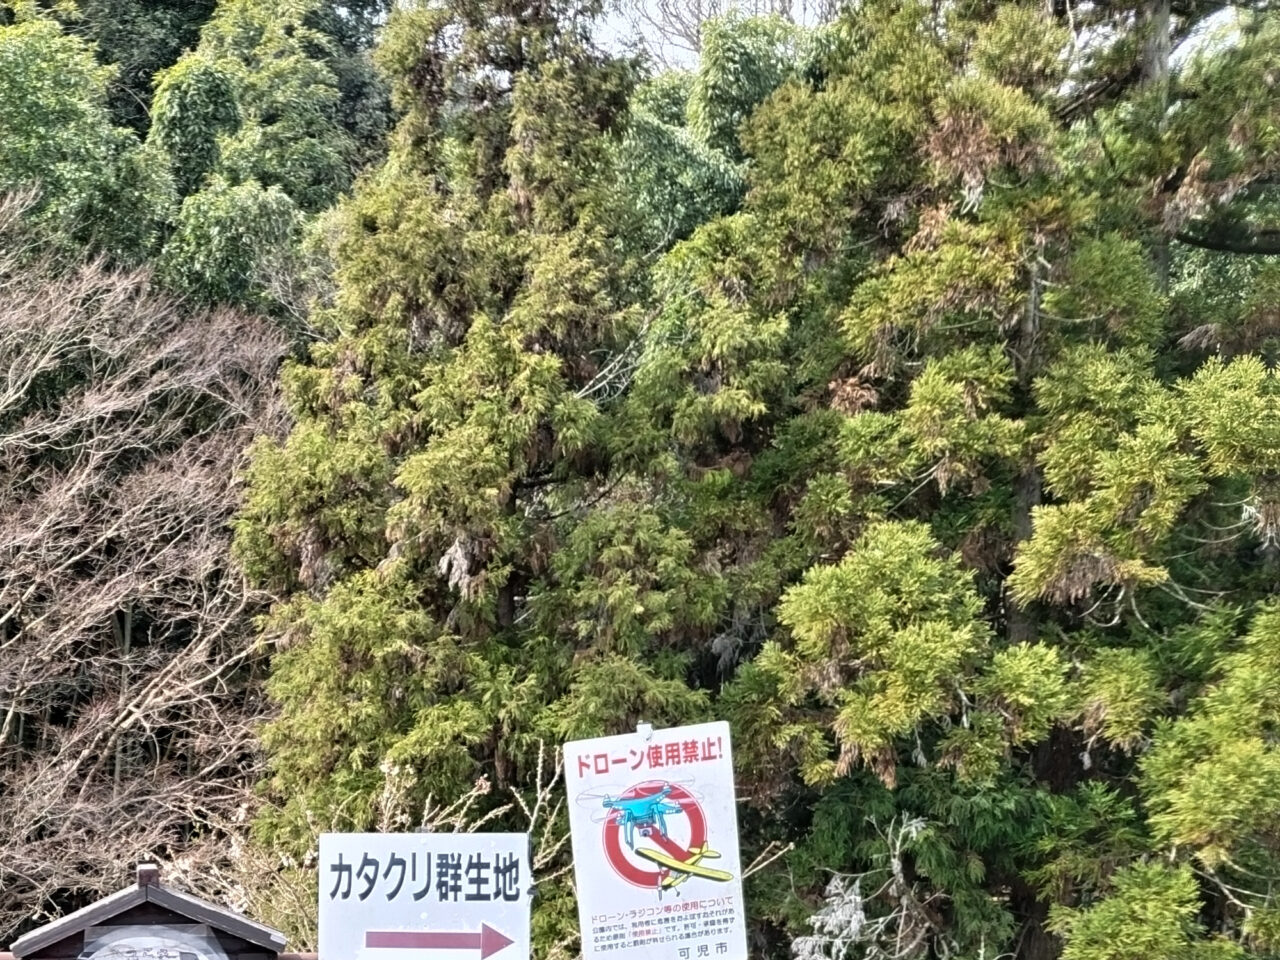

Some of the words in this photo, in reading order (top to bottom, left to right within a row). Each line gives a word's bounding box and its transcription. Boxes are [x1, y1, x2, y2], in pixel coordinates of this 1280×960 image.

[577, 736, 724, 777] ドローン使用禁止!
[329, 851, 520, 902] カタクリ群生地
[678, 942, 728, 960] 可児市
